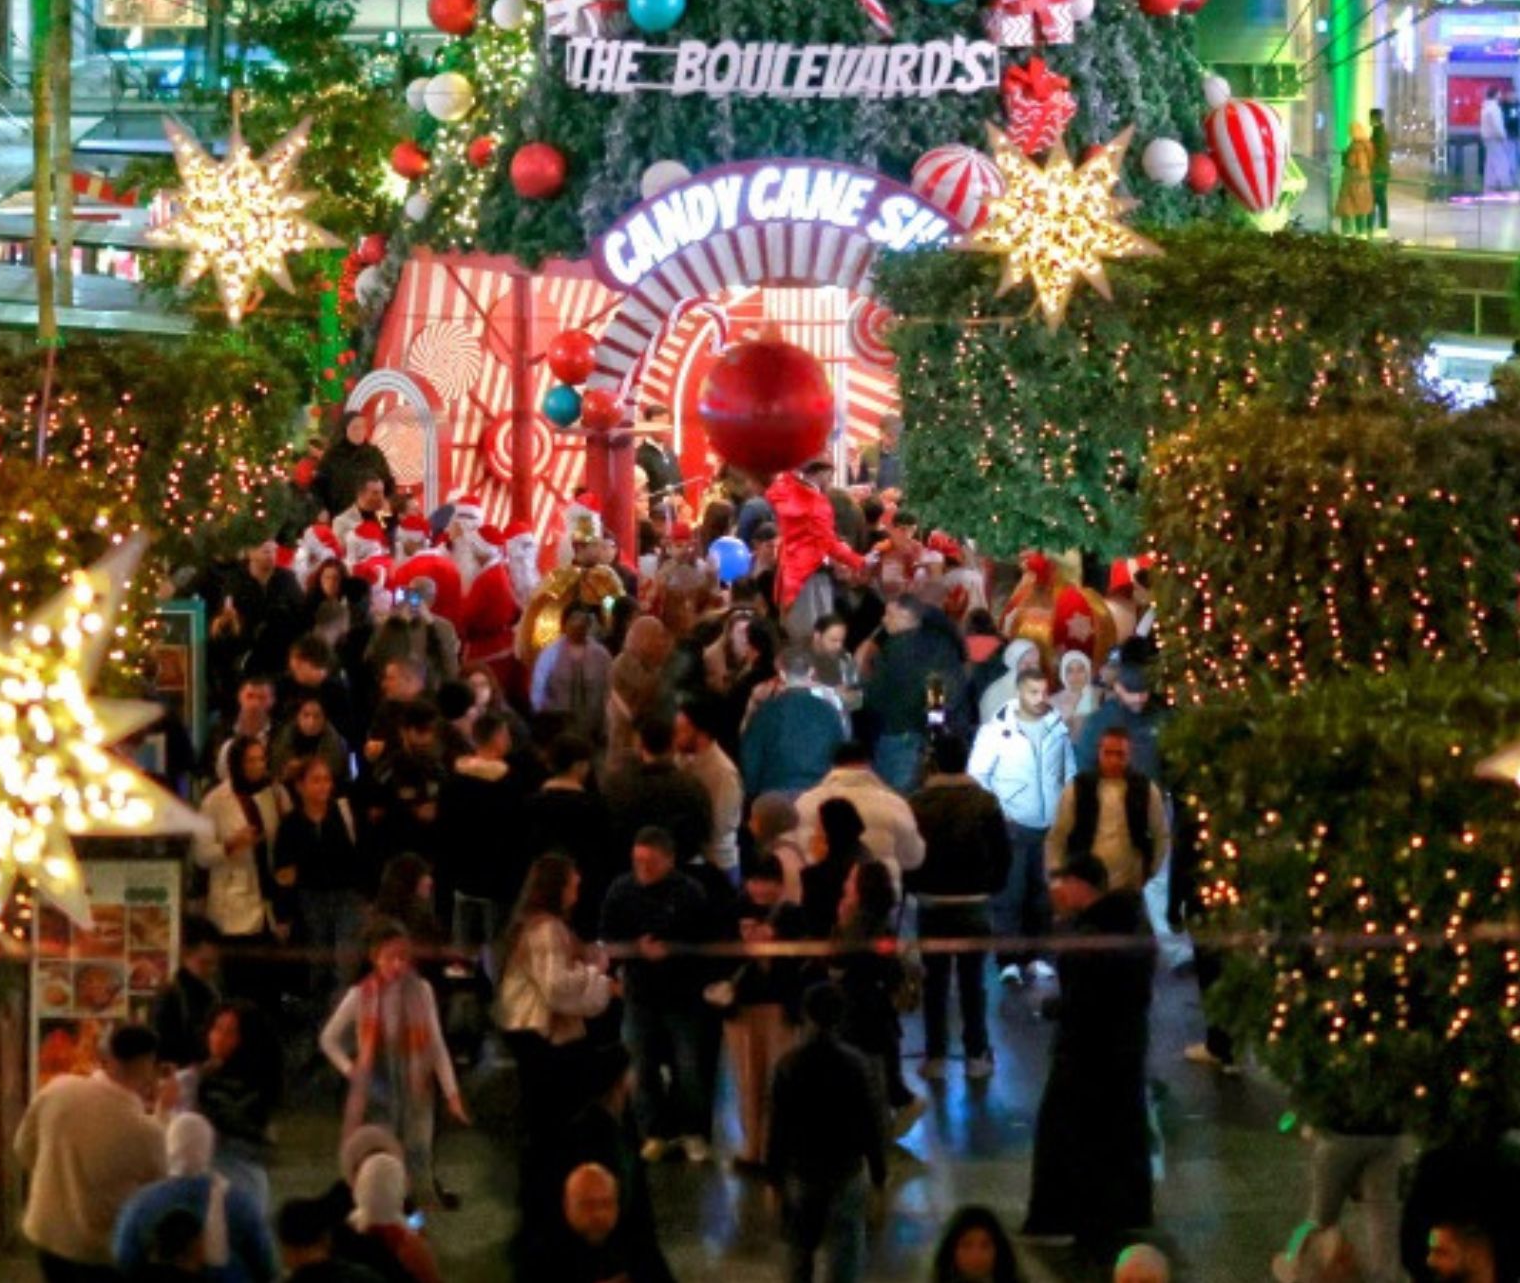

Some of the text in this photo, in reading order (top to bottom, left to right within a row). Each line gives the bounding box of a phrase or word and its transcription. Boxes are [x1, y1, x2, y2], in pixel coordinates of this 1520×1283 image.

[570, 34, 996, 99] THE BOULEVARD'S
[602, 165, 962, 286] CANDY CANE SH
